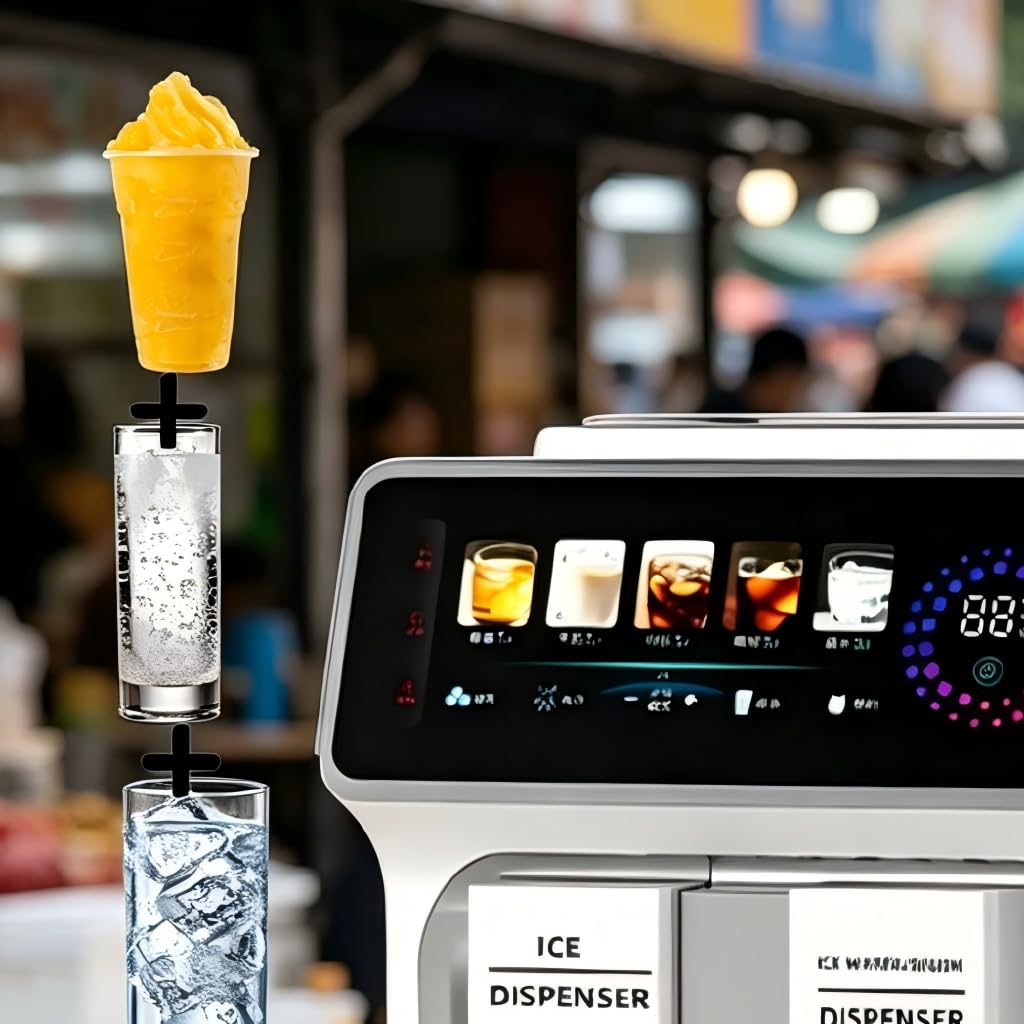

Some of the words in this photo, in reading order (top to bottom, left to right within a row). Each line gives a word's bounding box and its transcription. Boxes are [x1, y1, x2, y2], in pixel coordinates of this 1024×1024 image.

[960, 595, 1015, 637] 88
[537, 936, 581, 958] ICE
[490, 985, 650, 1009] DISPENSER
